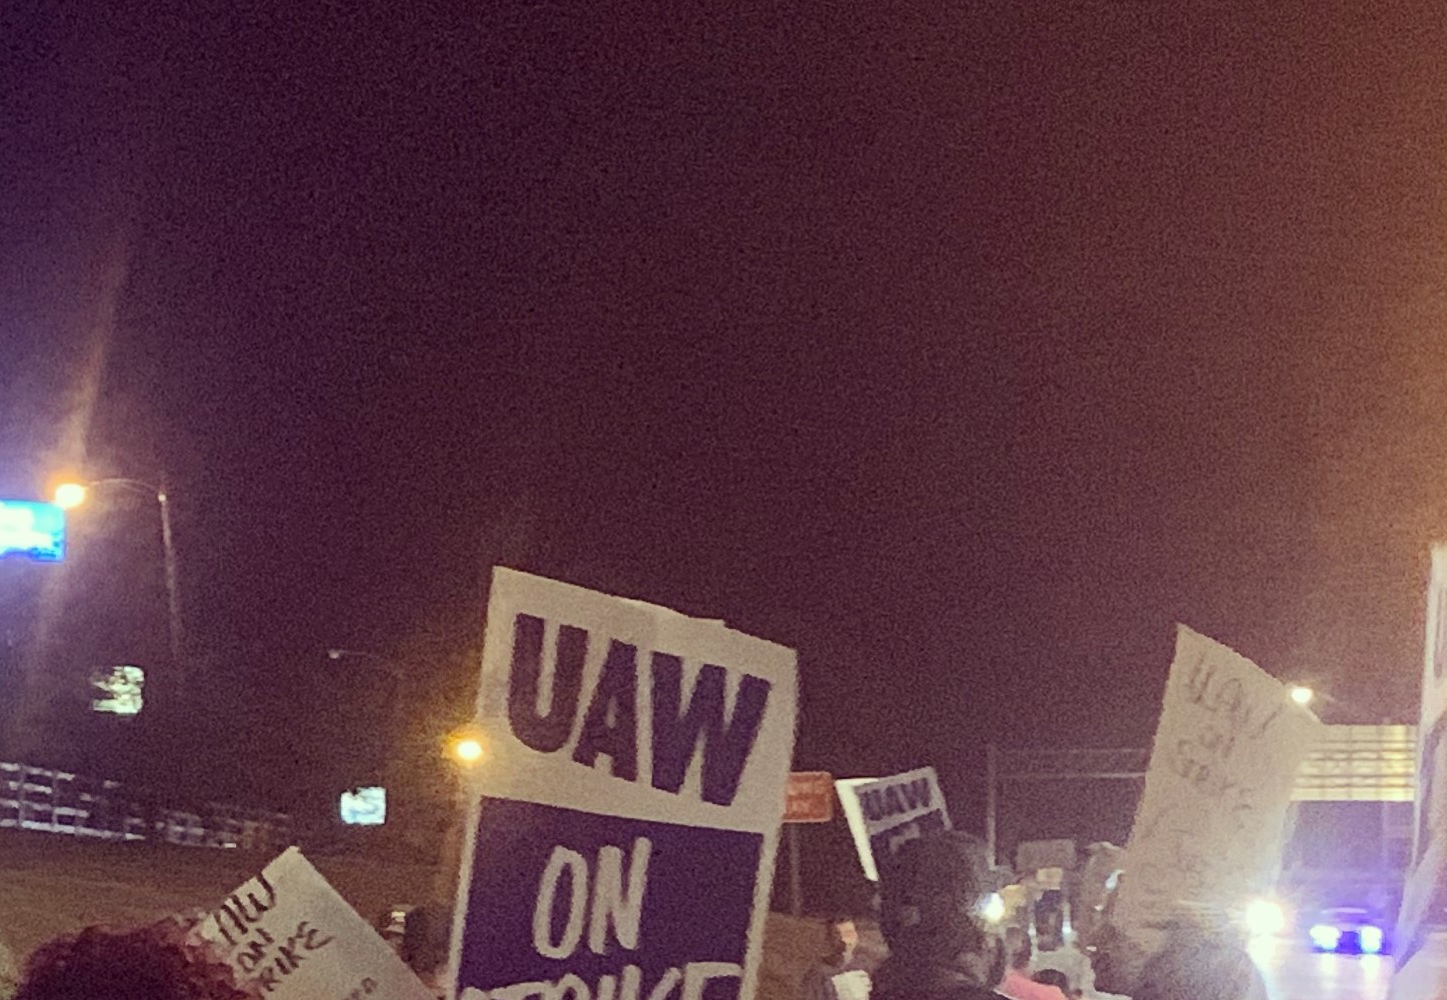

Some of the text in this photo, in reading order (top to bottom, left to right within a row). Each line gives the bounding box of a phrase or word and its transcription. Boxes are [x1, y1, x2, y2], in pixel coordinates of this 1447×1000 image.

[508, 613, 771, 806] UAW
[857, 777, 931, 821] UAW
[533, 837, 653, 959] ON
[257, 920, 336, 1000] RIKE
